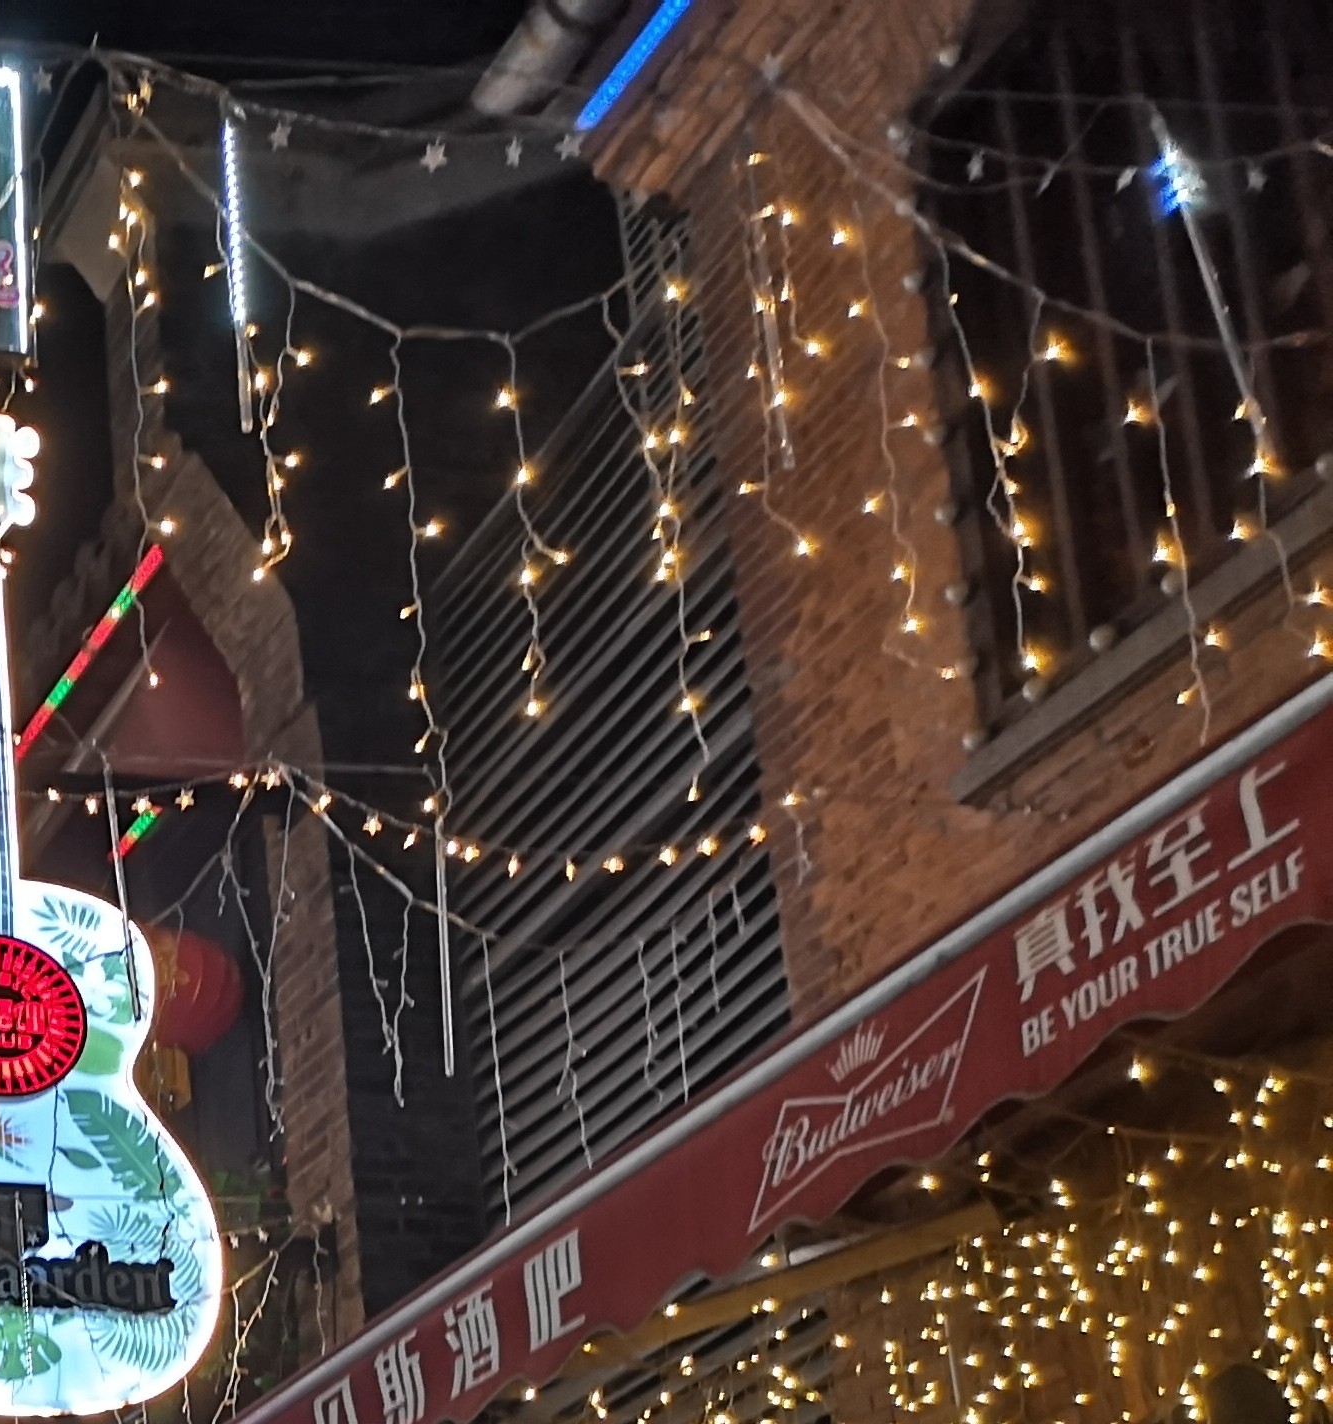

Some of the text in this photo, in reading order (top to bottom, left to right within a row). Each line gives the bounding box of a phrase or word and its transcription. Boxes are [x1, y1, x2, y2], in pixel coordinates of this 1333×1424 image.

[1014, 760, 1300, 1004] 真我至上
[1021, 846, 1305, 1057] BE YOUR TRUE SELF
[763, 1039, 961, 1188] Budweiser
